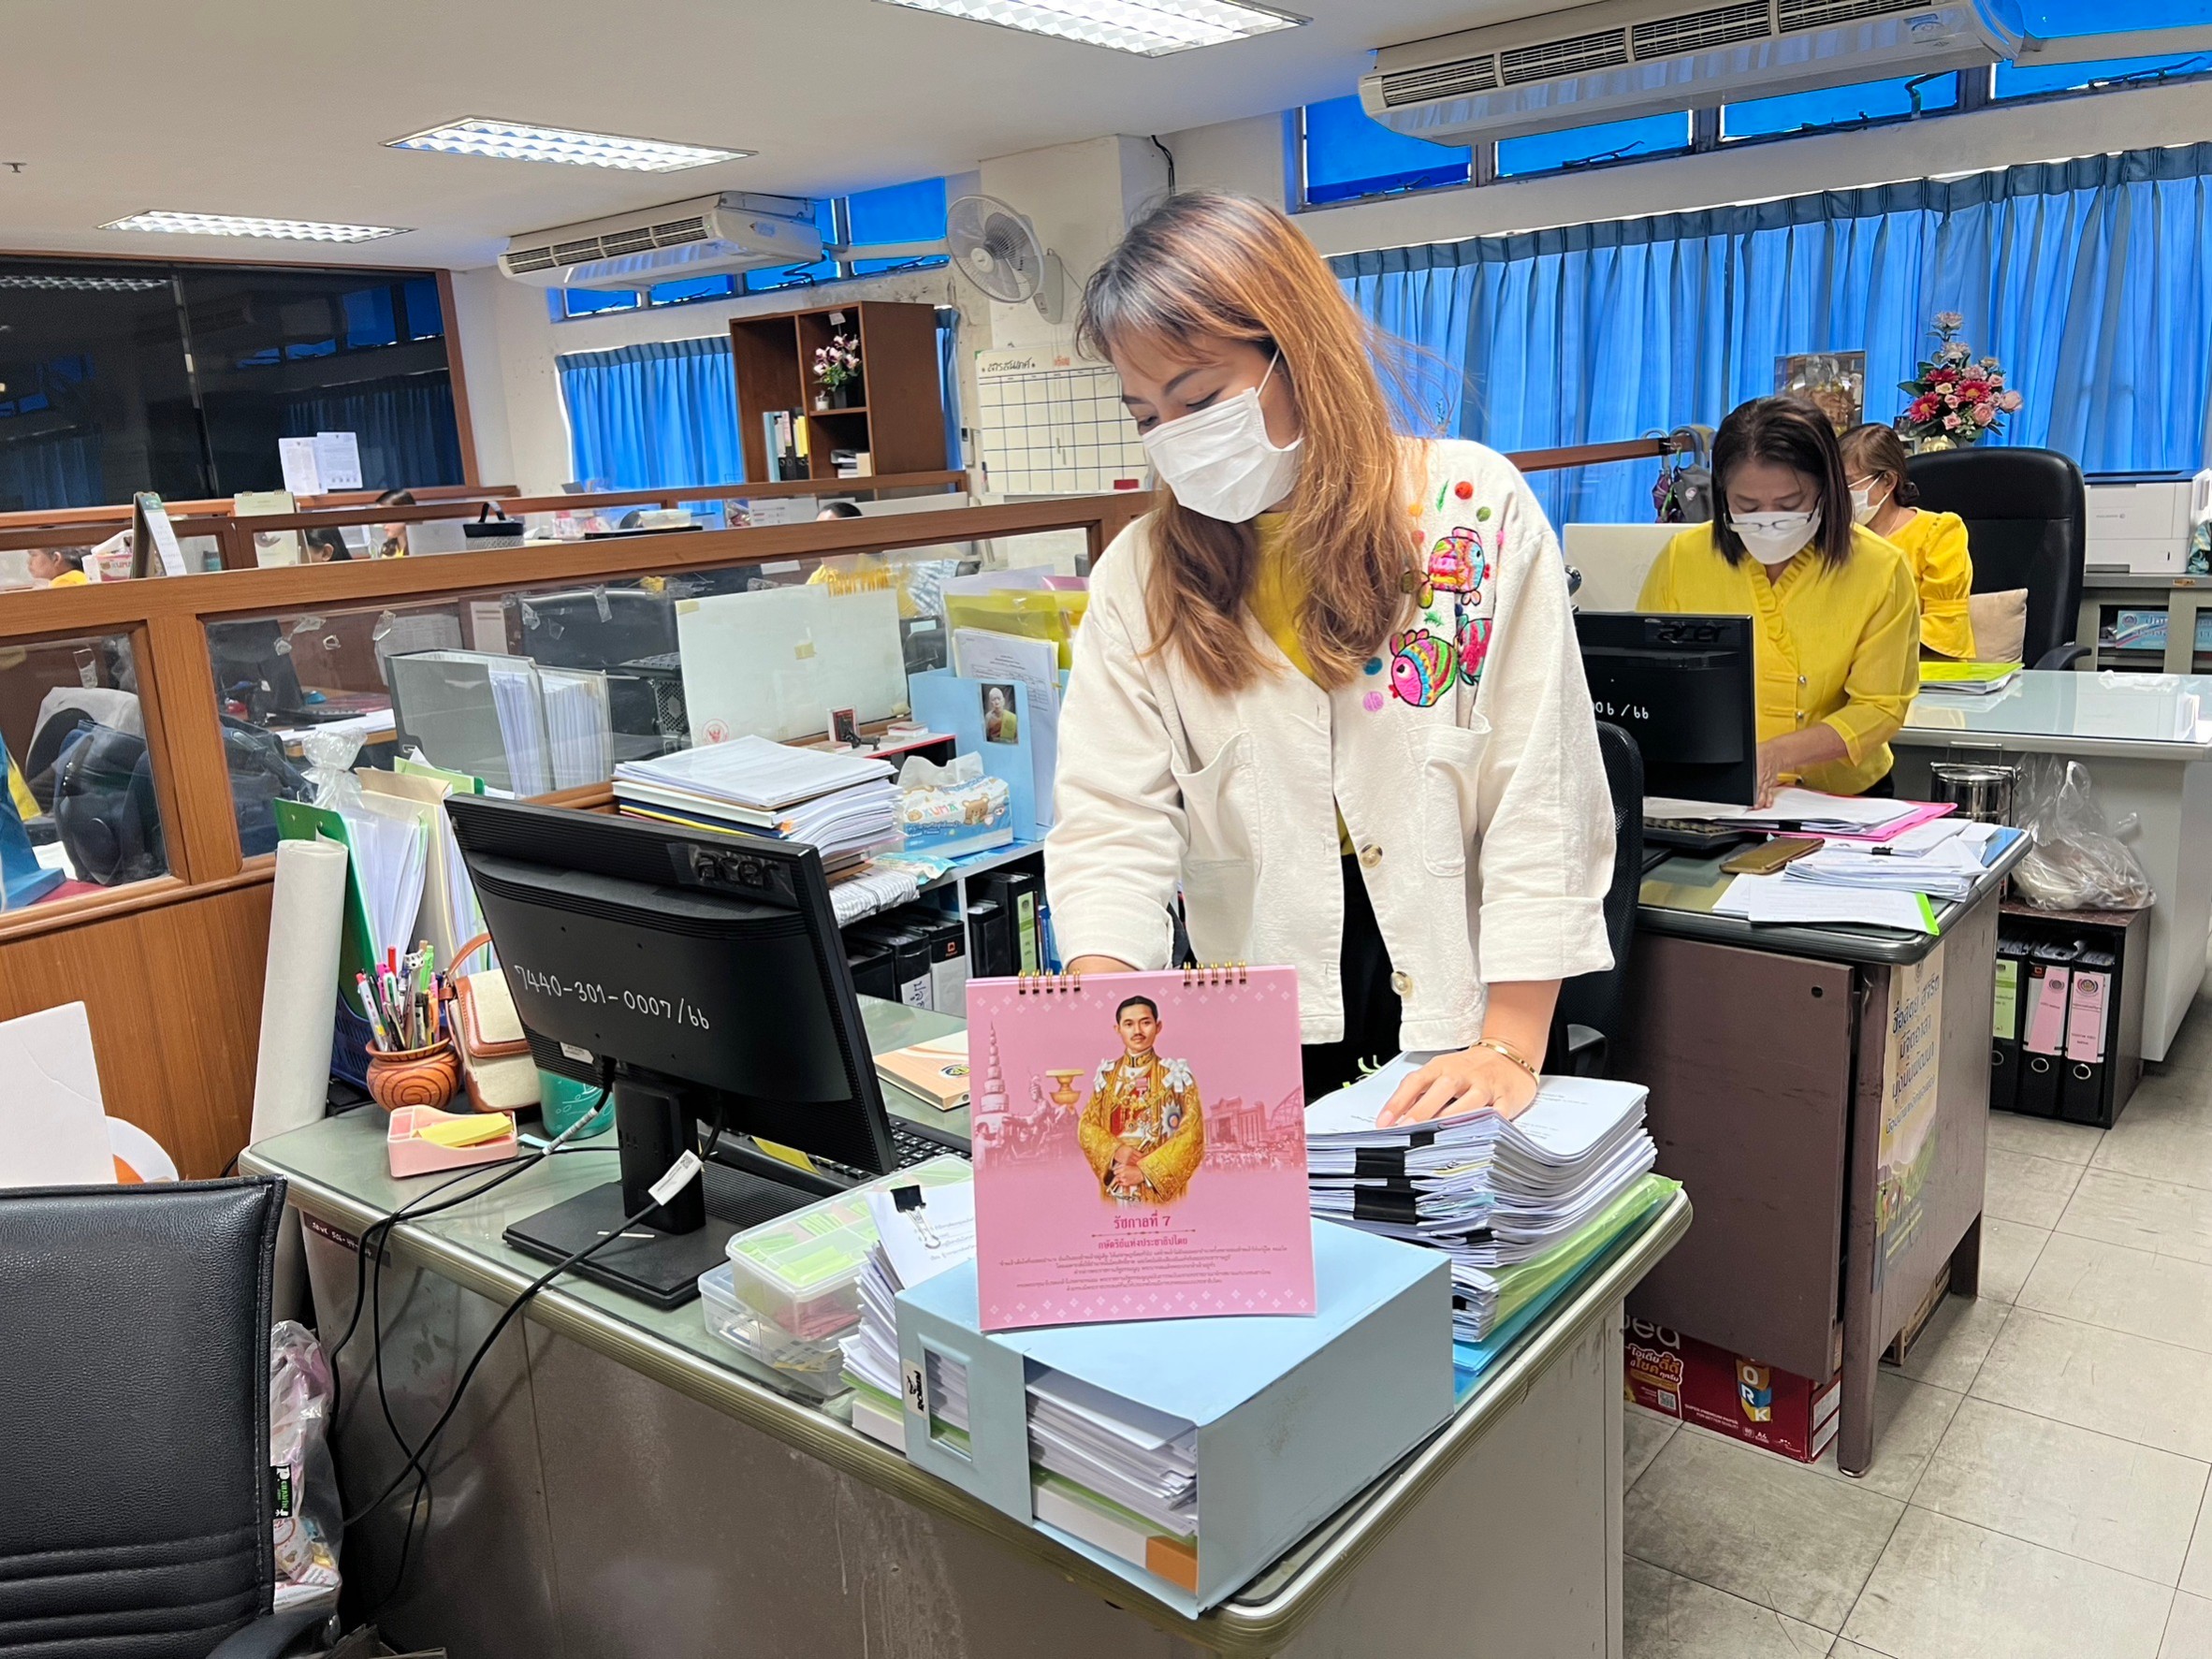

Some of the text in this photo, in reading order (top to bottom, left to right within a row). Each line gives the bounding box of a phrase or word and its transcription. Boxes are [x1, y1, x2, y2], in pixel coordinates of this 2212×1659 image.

[1113, 1210, 1171, 1230] รัชกาลที่ 7
